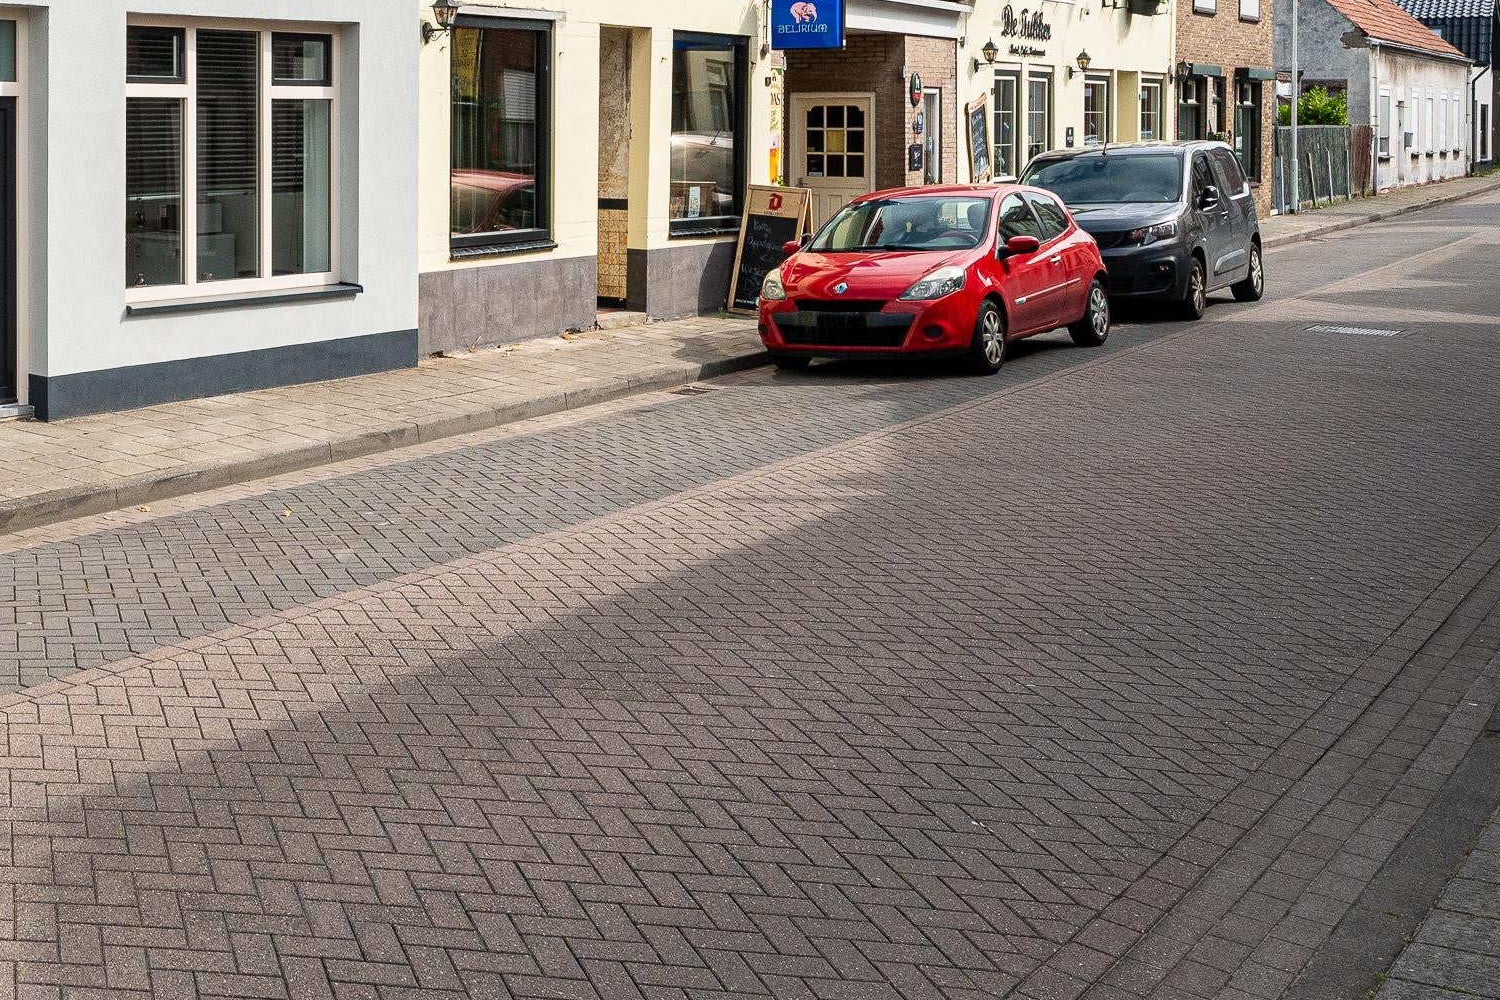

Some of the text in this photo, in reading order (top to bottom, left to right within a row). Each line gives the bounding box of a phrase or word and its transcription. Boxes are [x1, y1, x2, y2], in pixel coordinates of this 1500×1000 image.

[777, 24, 828, 34] DELIRIUM
[1001, 4, 1051, 41] De Tukker
